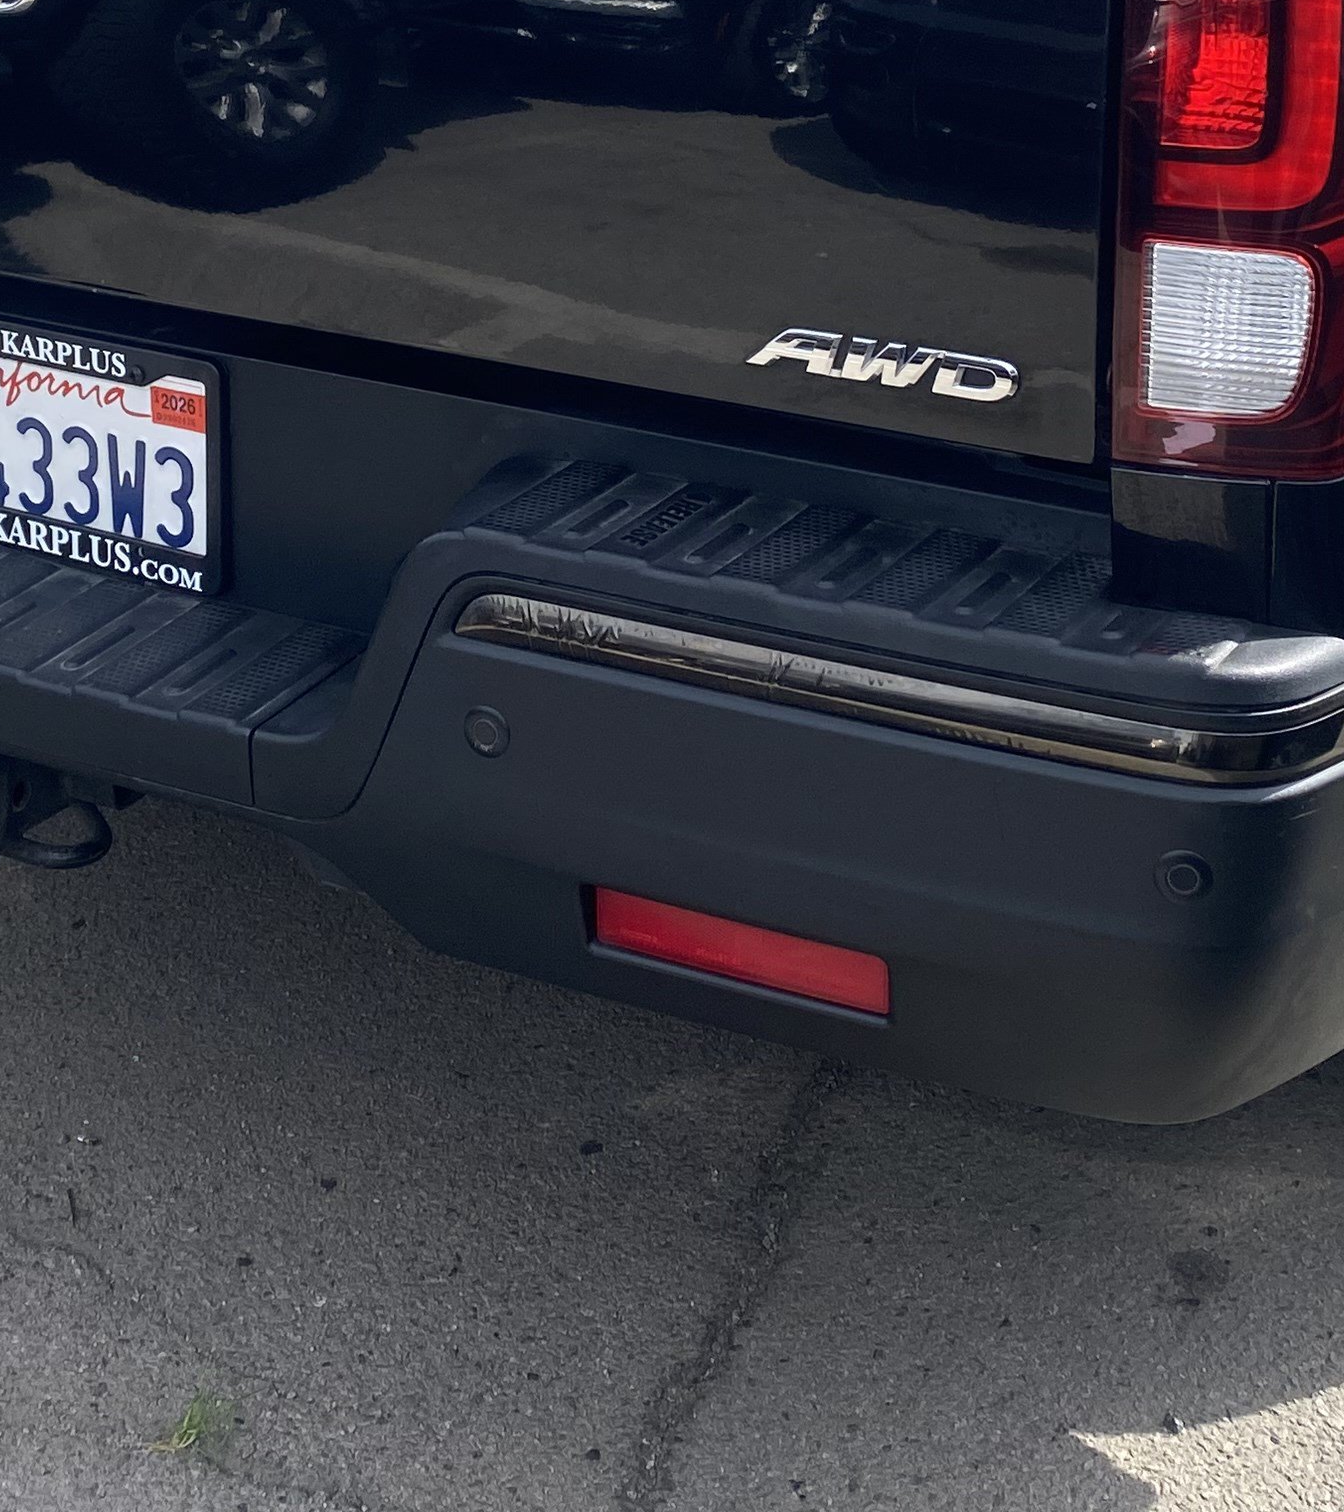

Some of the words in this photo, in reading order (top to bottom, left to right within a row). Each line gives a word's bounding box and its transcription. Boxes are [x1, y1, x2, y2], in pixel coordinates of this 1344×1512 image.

[0, 329, 127, 377] KARPLUS
[745, 327, 1020, 402] AWD
[161, 392, 196, 415] 2026
[620, 497, 704, 548] RELEASE
